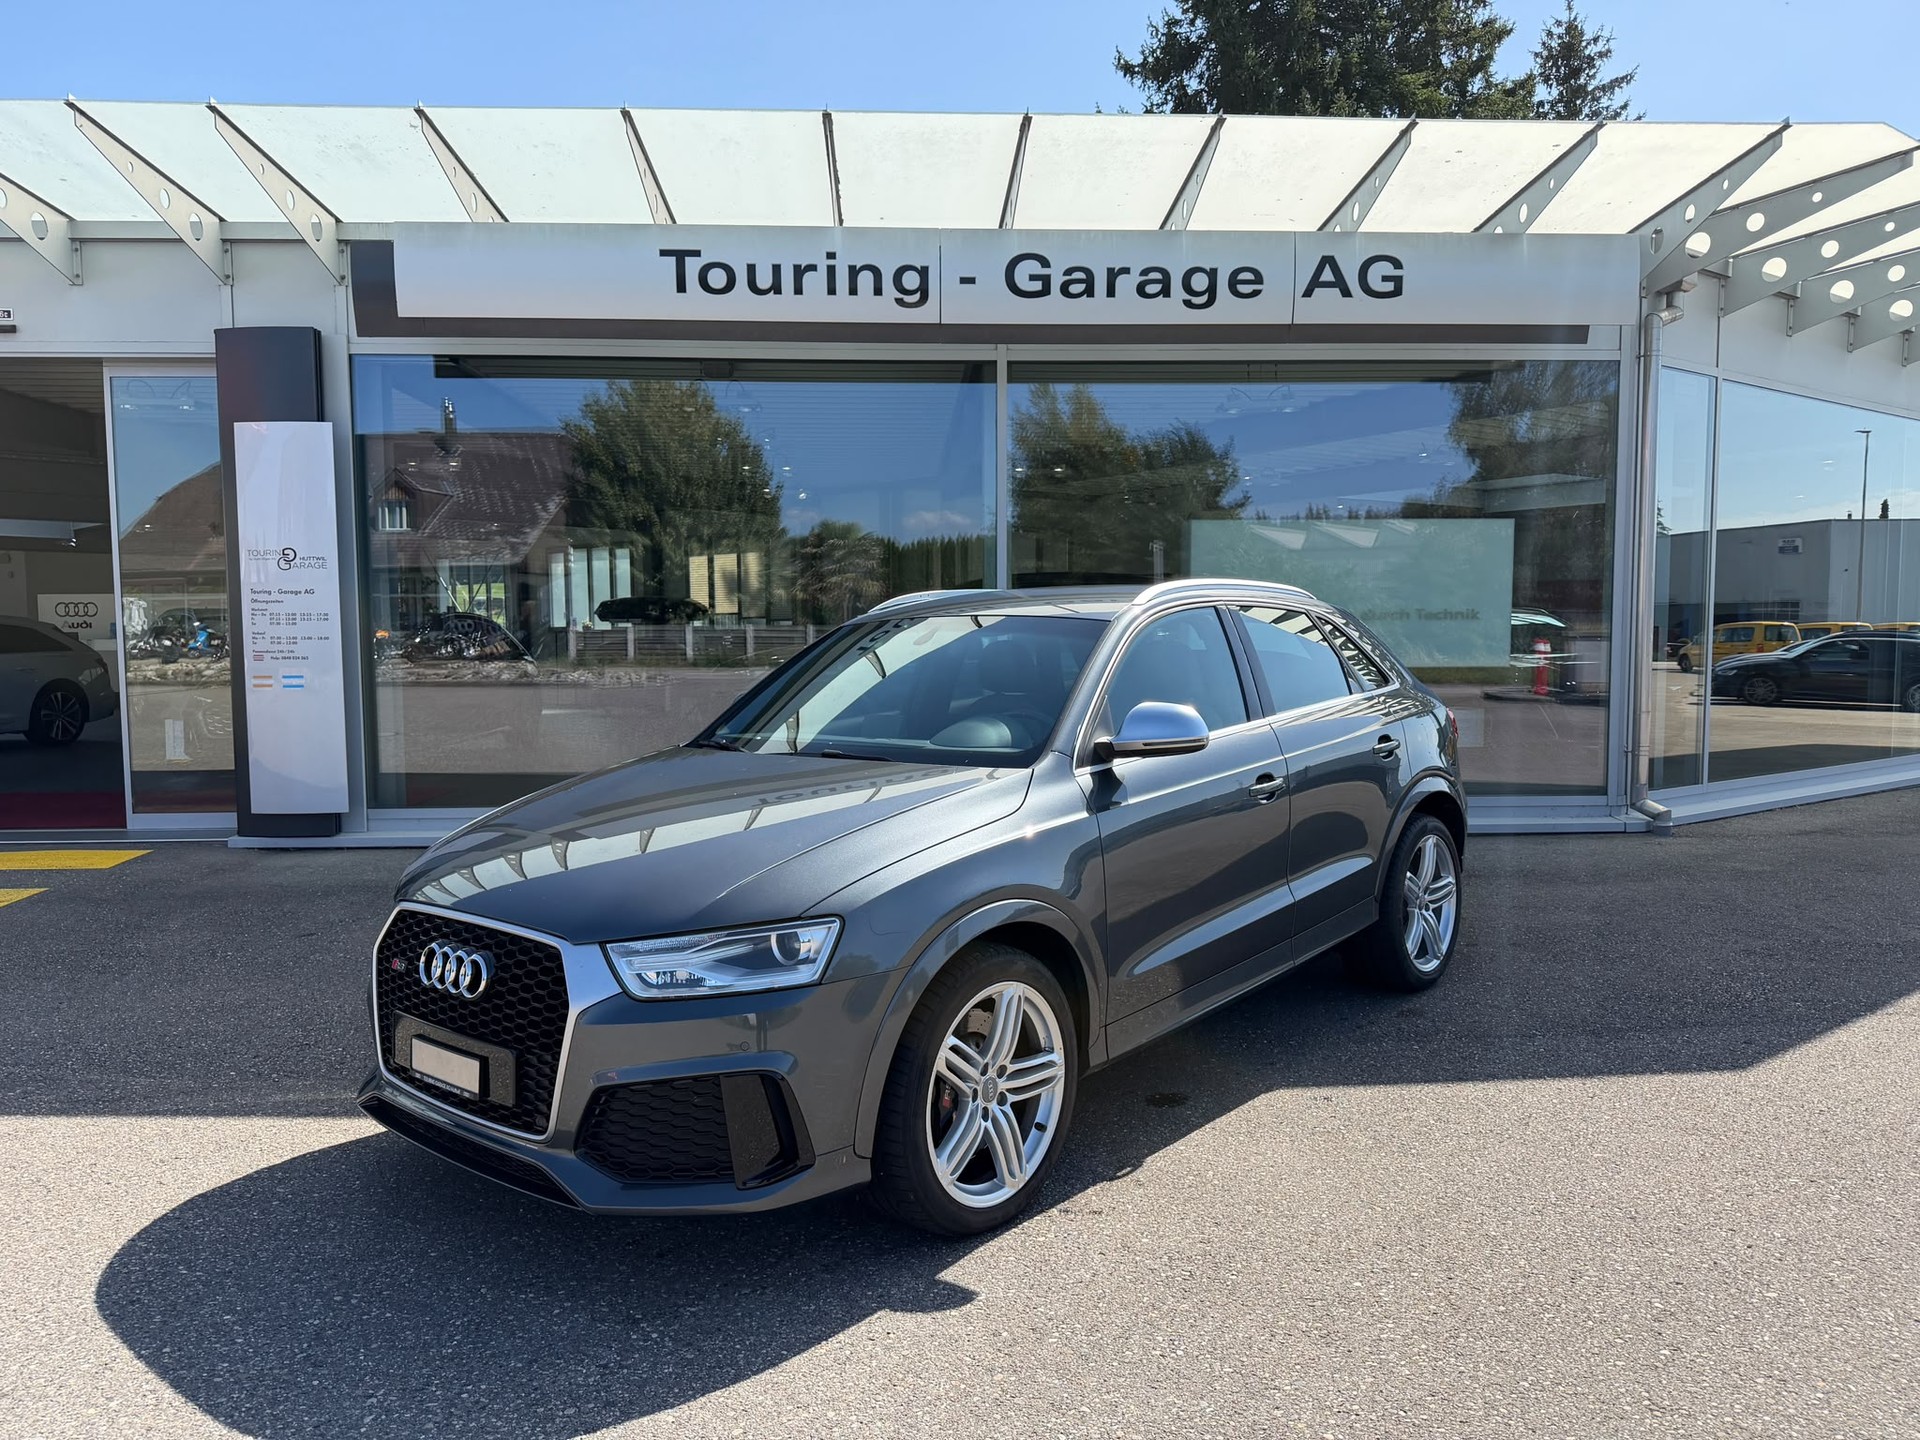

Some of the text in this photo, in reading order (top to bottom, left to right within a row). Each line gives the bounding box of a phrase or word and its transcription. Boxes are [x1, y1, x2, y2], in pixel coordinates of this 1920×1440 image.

[658, 248, 1405, 311] Touring - Garage AG
[277, 556, 328, 571] GARAGE
[250, 588, 272, 596] Touring
[277, 588, 302, 596] Garage
[1416, 608, 1480, 620] Technik
